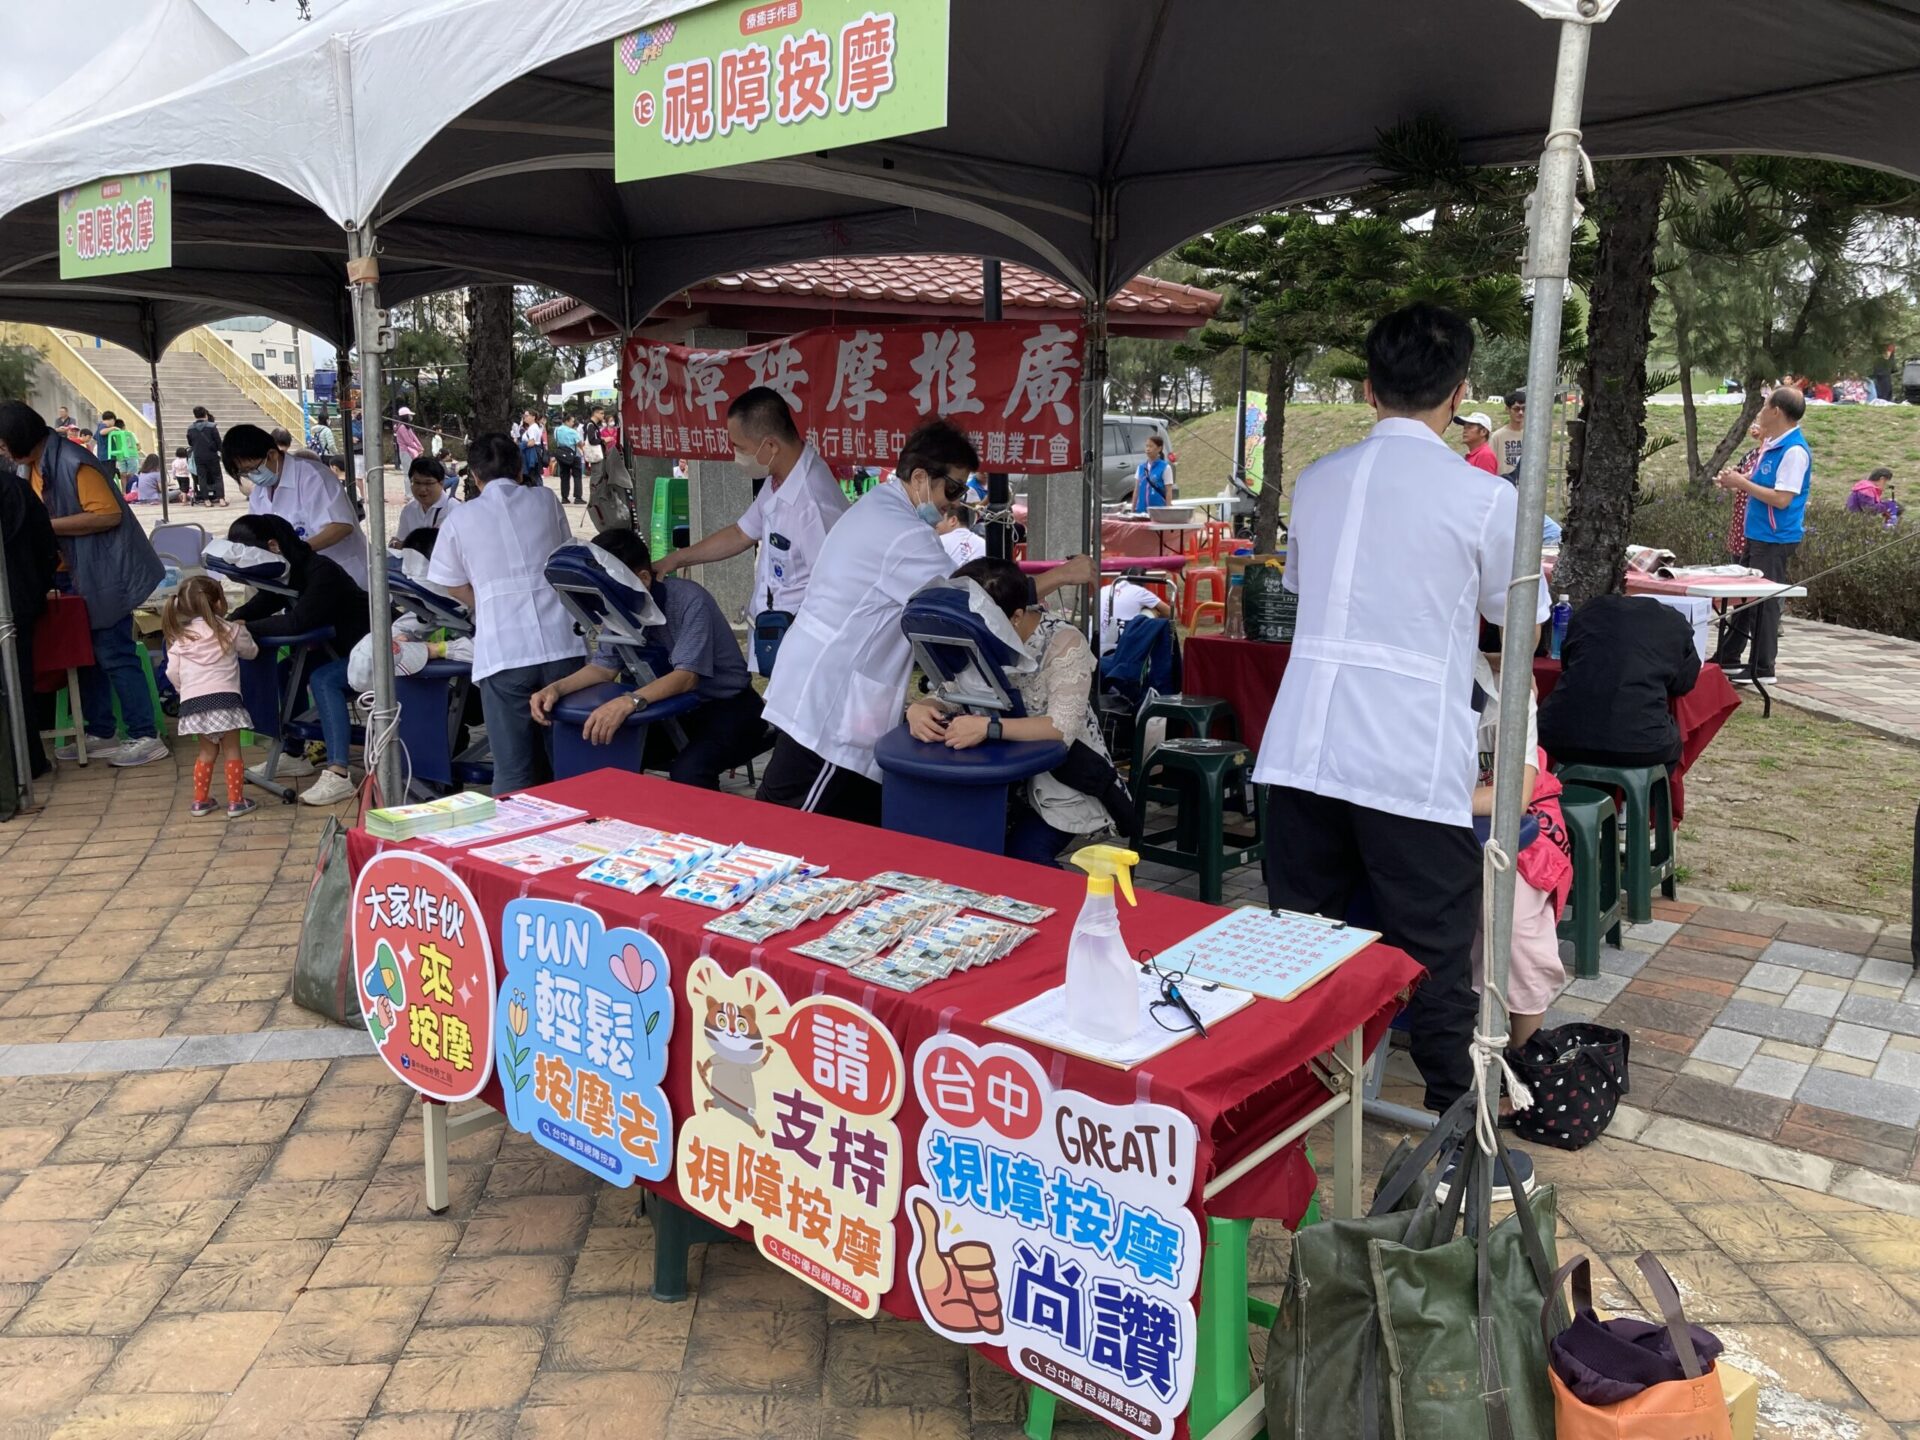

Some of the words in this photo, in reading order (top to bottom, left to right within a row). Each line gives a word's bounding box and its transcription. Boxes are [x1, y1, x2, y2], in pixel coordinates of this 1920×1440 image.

[746, 2, 798, 29] 療癒手作區
[662, 14, 893, 142] 視障按摩
[77, 196, 154, 258] 視障按摩
[630, 324, 1080, 425] 視障按摩推廣
[364, 883, 465, 947] 大家作伙
[515, 912, 591, 969] FUN
[408, 1003, 474, 1072] 按摩
[534, 967, 636, 1081] 輕鬆
[811, 1013, 870, 1102] 請
[533, 1052, 660, 1167] 按摩去
[931, 1054, 1029, 1127] 台中
[771, 1088, 889, 1208] 支持
[1055, 1105, 1178, 1186] GREAT!
[685, 1135, 881, 1280] 視障按摩
[930, 1133, 1182, 1285] 視障按摩
[1010, 1241, 1179, 1399] 尚讚
[1045, 1362, 1152, 1428] 台中優良視障按摩
